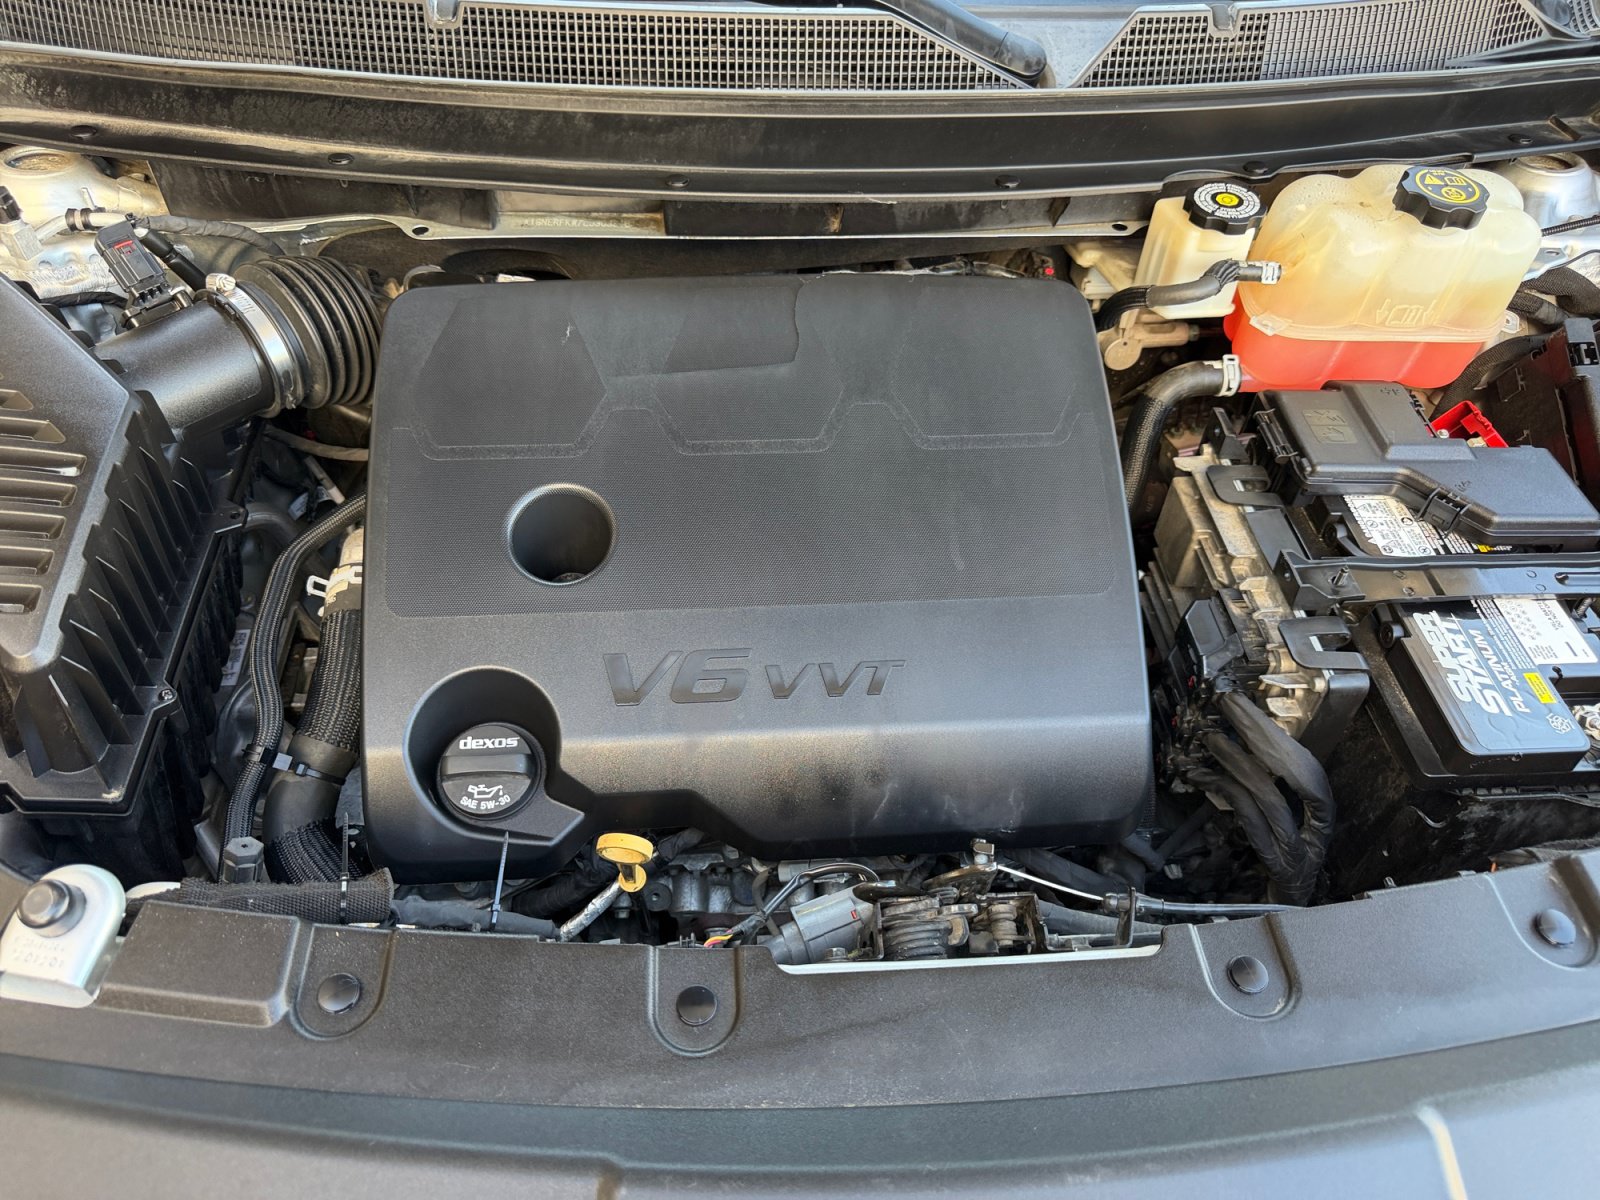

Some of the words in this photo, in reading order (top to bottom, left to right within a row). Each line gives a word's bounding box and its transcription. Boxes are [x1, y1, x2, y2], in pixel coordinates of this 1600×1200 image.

[603, 647, 753, 707] V6
[764, 659, 906, 700] VVT
[1413, 612, 1472, 703] SUPER
[1429, 610, 1513, 717] START
[1468, 629, 1532, 713] PLATINUM
[459, 735, 521, 750] dexos
[459, 795, 479, 810] SAE
[479, 794, 512, 810] 5W-30
